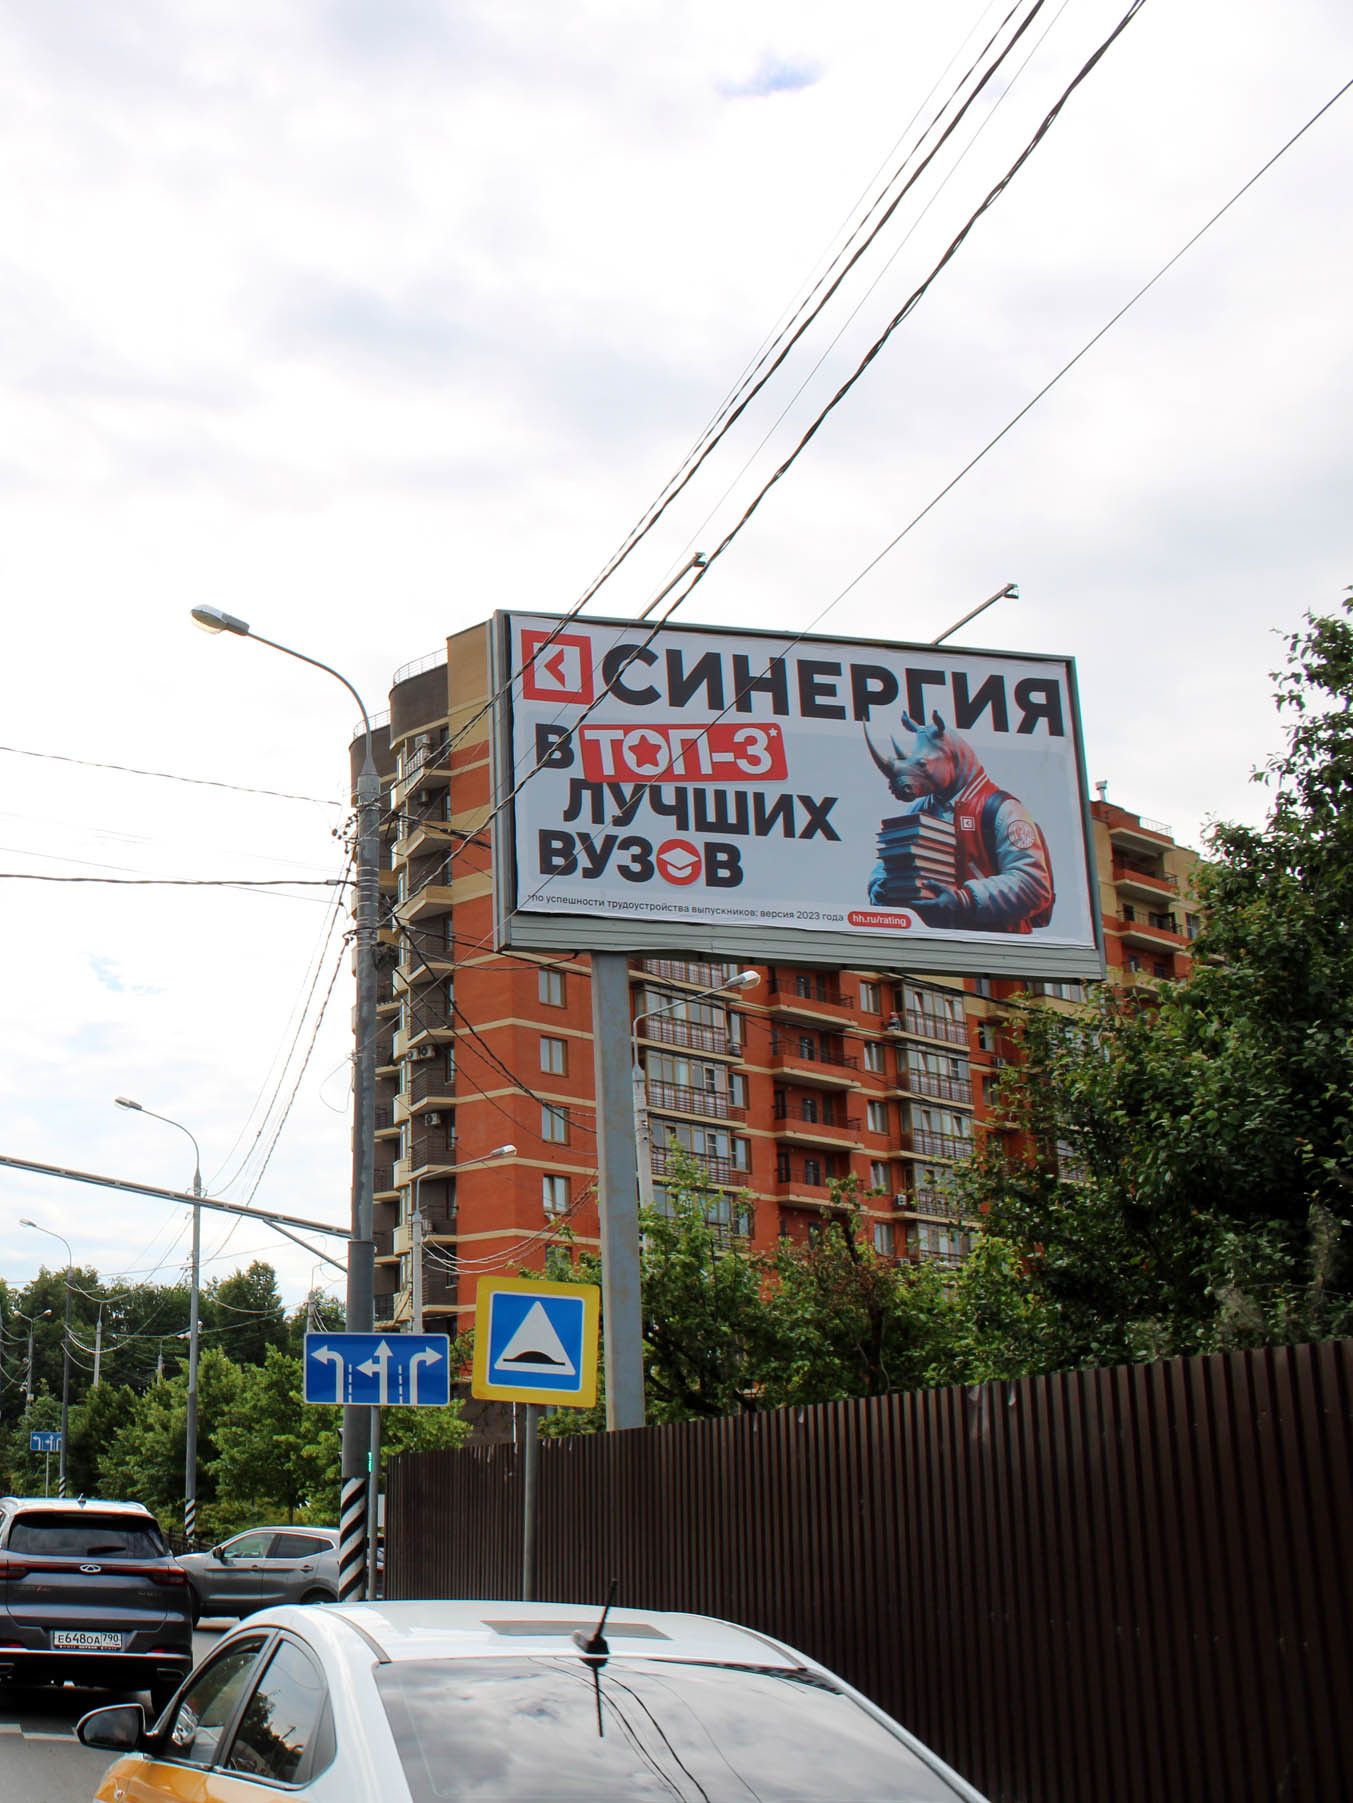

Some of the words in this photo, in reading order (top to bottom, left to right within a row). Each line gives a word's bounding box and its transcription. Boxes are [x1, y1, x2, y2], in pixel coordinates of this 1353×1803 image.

[602, 643, 1065, 737] СИНЕРГИЯ
[535, 723, 575, 769] В
[563, 778, 842, 841] ЛУЧШИХ
[538, 829, 744, 888] ВУЗОВ
[546, 895, 605, 907] успешности
[607, 900, 690, 913] трудоустройства
[760, 910, 794, 920] версия
[796, 910, 819, 920] 2023
[822, 913, 844, 922] года
[852, 913, 907, 926] hh.ru/rating
